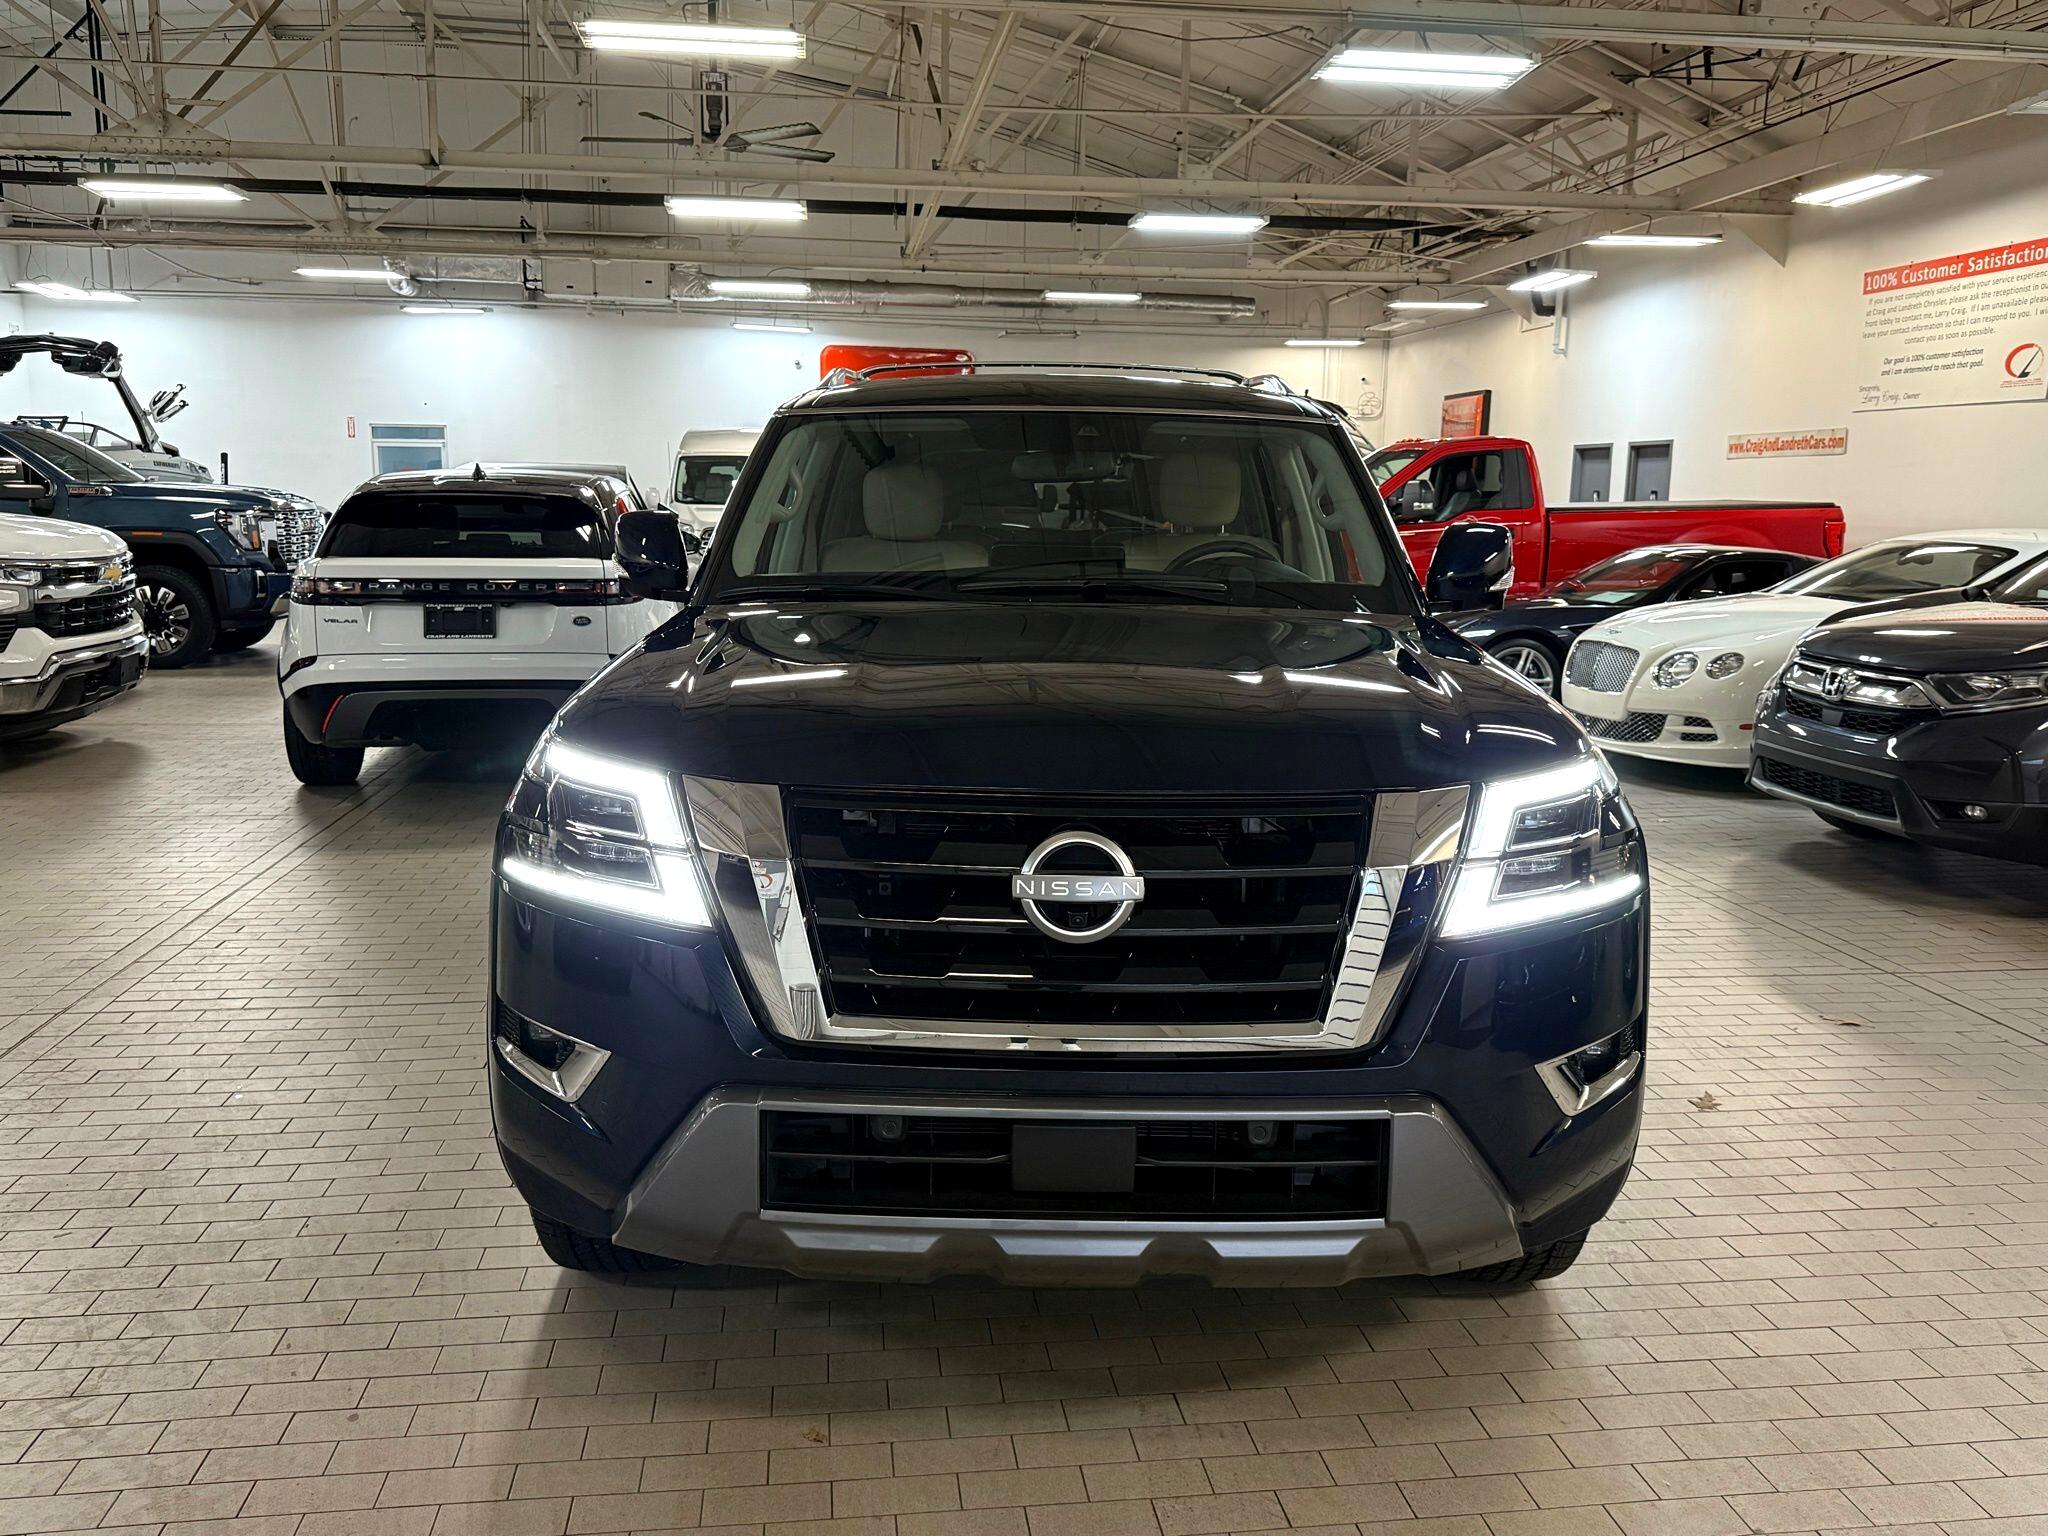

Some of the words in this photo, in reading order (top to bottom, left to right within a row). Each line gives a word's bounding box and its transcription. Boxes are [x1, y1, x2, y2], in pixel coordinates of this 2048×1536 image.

[1866, 272, 1898, 290] 100%
[1902, 262, 1964, 284] Customer
[1905, 289, 1935, 299] completely
[1936, 283, 1960, 295] satisfied
[1977, 280, 1991, 289] your
[1992, 276, 2015, 285] service
[1898, 302, 1922, 312] Landreth
[1949, 296, 1968, 305] please
[1969, 292, 1979, 300] ask
[1993, 285, 2031, 296] receptionist
[1865, 319, 1878, 327] front
[1902, 314, 1922, 322] contact
[1970, 304, 1976, 312] If
[1992, 298, 2028, 309] unavailable
[1890, 326, 1910, 335] contact
[1911, 322, 1944, 332] information
[1982, 312, 2008, 323] respond
[2017, 311, 2032, 319] you.
[1945, 332, 1960, 340] soon
[1969, 326, 1995, 338] possible.
[1893, 356, 1905, 365] goal
[1926, 352, 1950, 360] customer
[1951, 349, 1984, 358] satisfaction
[1903, 364, 1932, 374] determined
[1957, 361, 1968, 369] that
[1728, 435, 1844, 455] www.CraigAndLandrethCars.com
[368, 583, 450, 591] RANGE
[466, 583, 547, 591] ROVER
[1016, 880, 1140, 896] NISSAN
